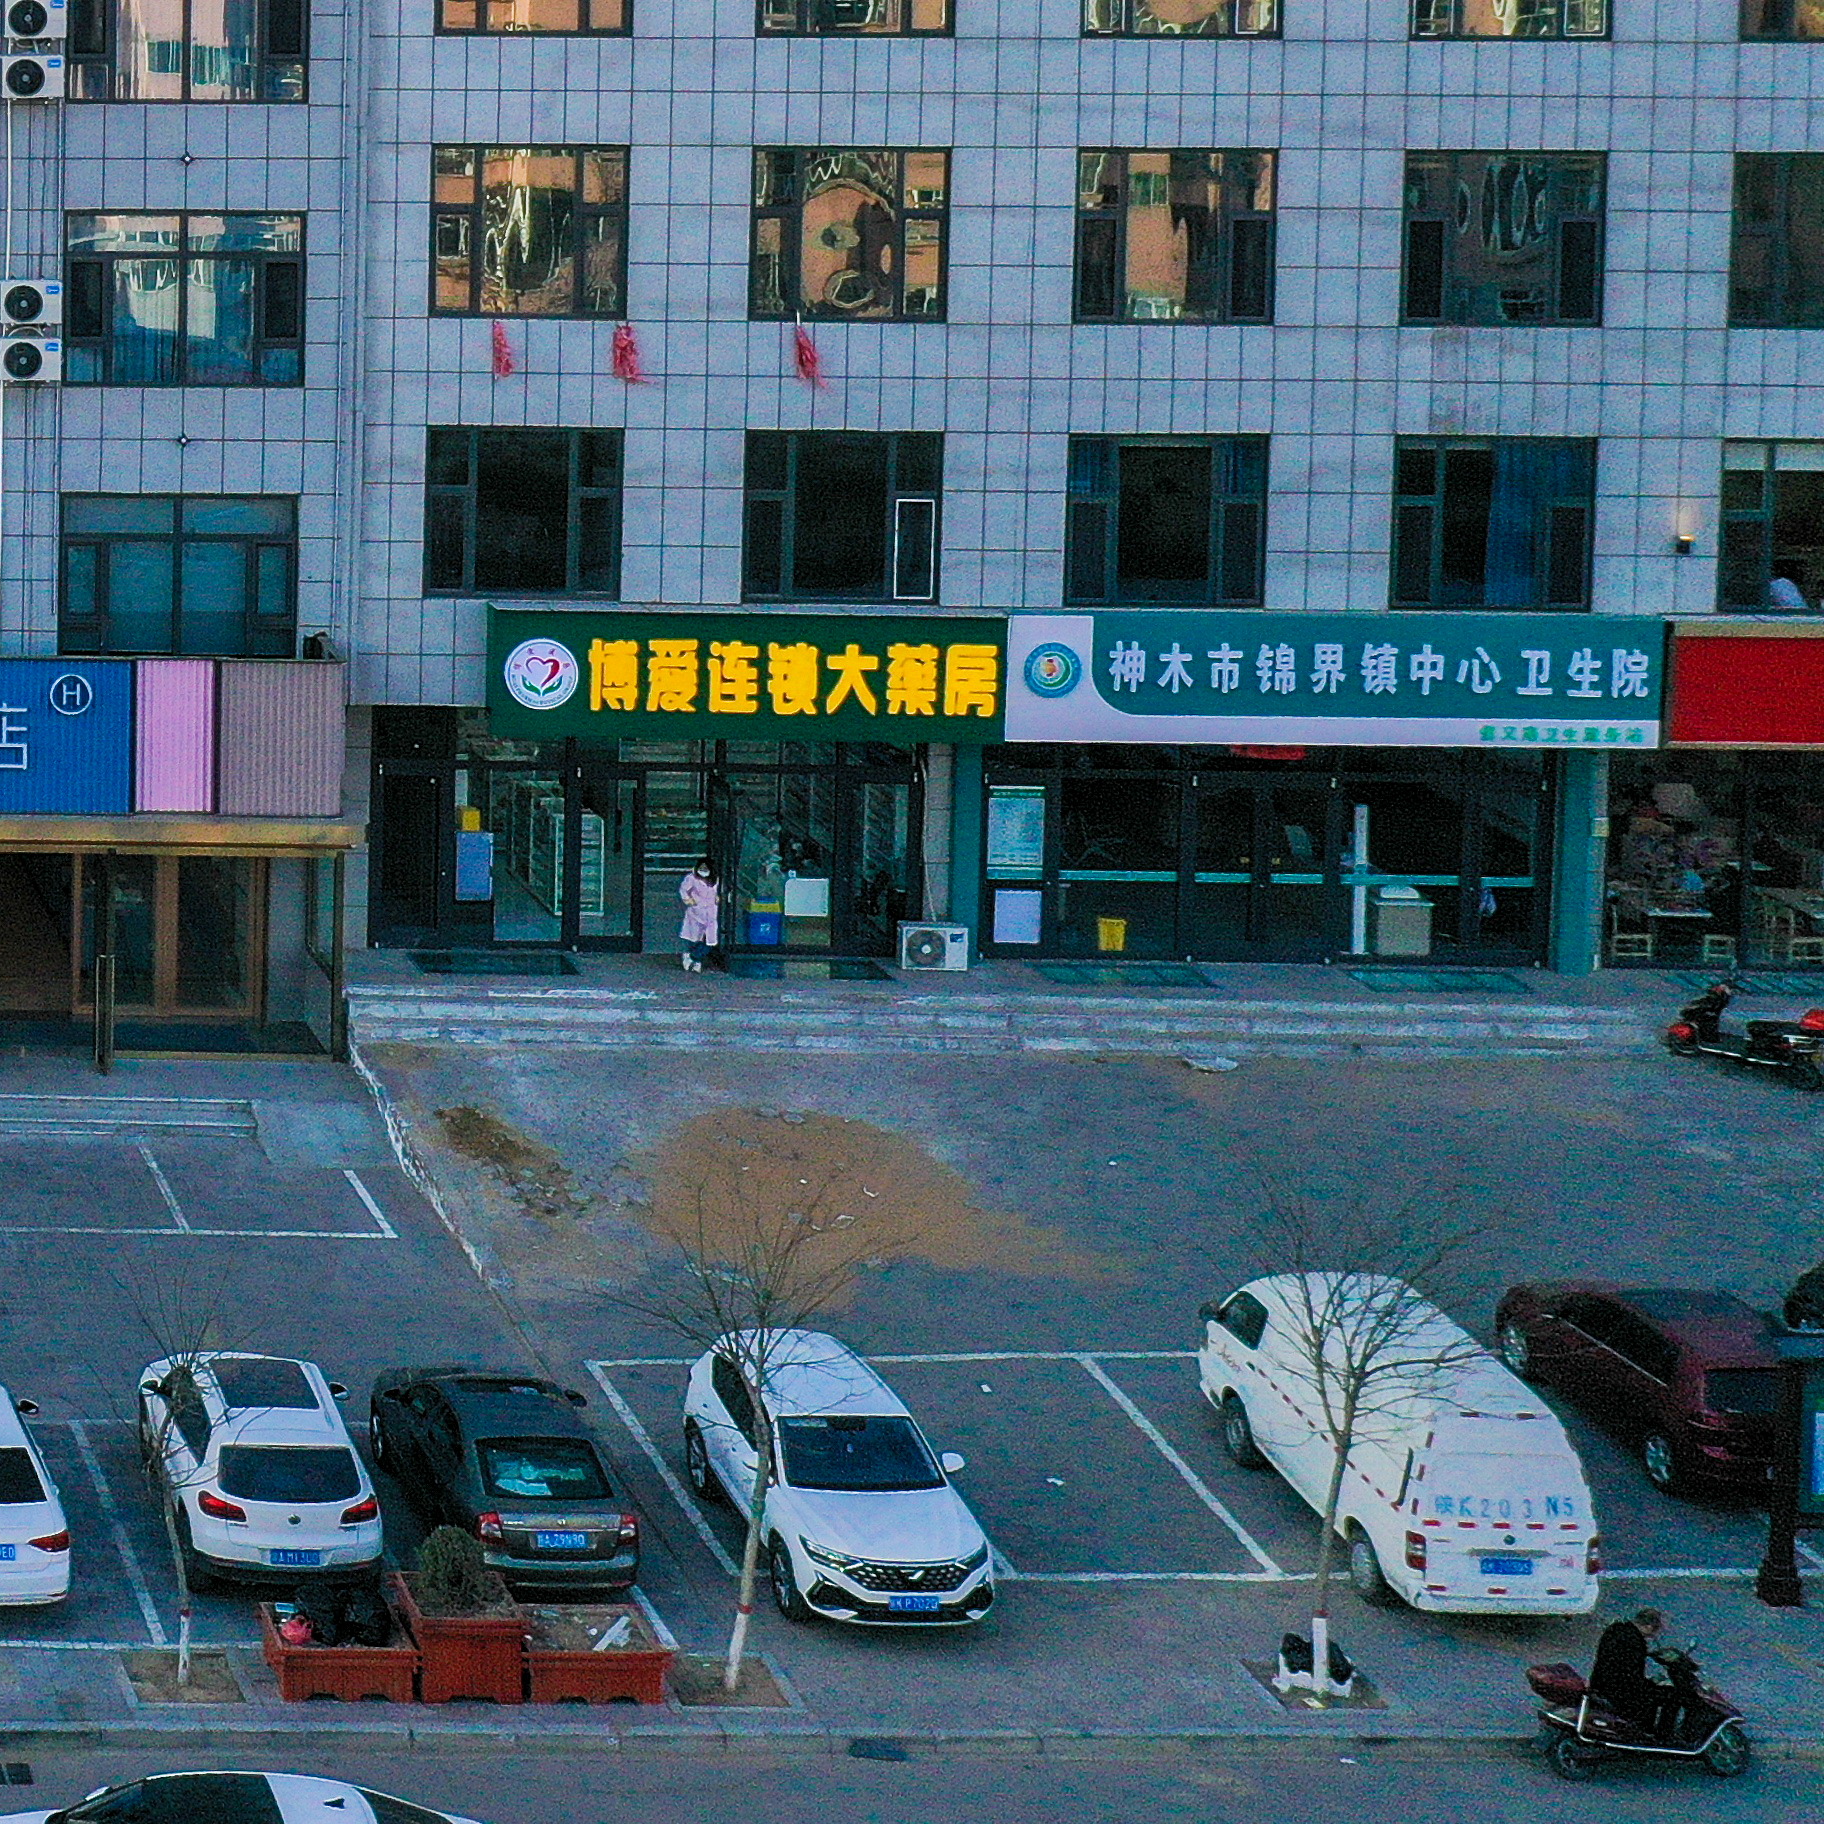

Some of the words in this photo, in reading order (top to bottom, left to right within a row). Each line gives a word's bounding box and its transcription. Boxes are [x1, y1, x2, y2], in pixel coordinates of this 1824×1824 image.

[1108, 640, 1650, 699] 神木市锦界镇中心卫生院
